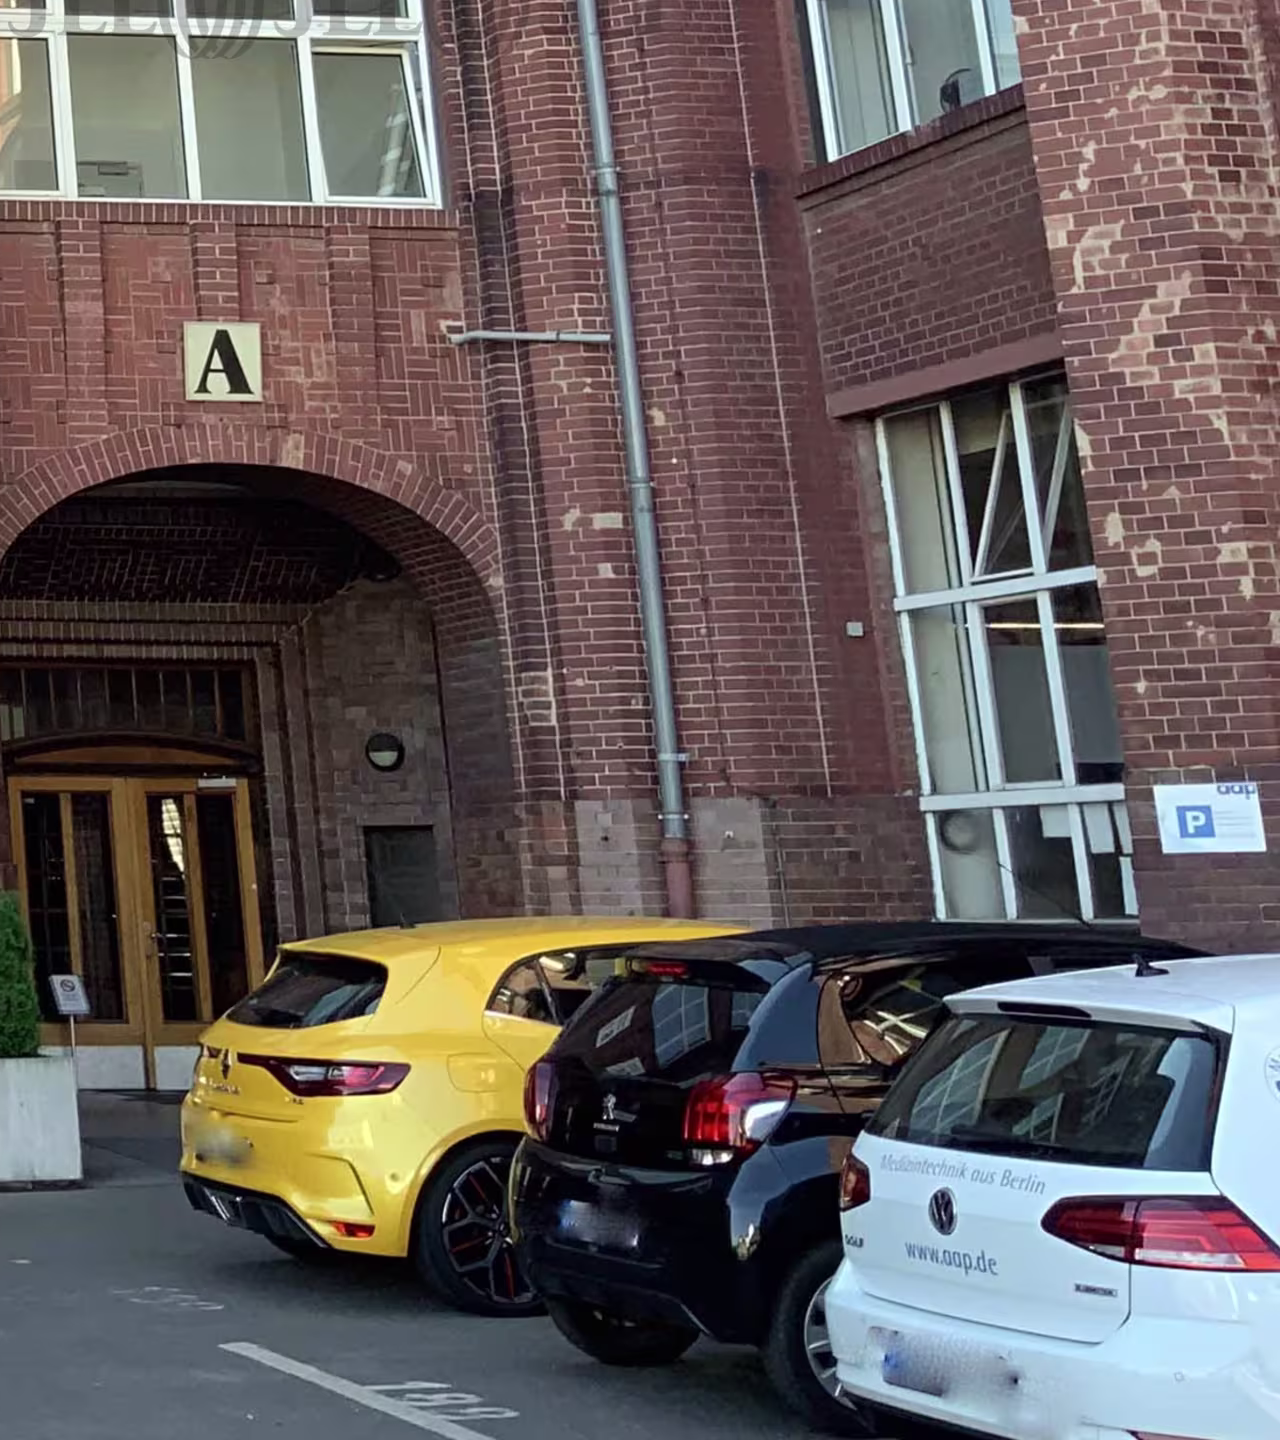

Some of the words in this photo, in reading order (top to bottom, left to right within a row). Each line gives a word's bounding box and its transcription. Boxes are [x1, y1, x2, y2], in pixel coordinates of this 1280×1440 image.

[194, 329, 254, 394] A
[1185, 810, 1206, 834] P
[880, 1154, 968, 1180] Medizintechnik
[970, 1168, 996, 1185] aus
[1000, 1168, 1046, 1195] Berlin
[904, 1242, 998, 1276] www.aap.de
